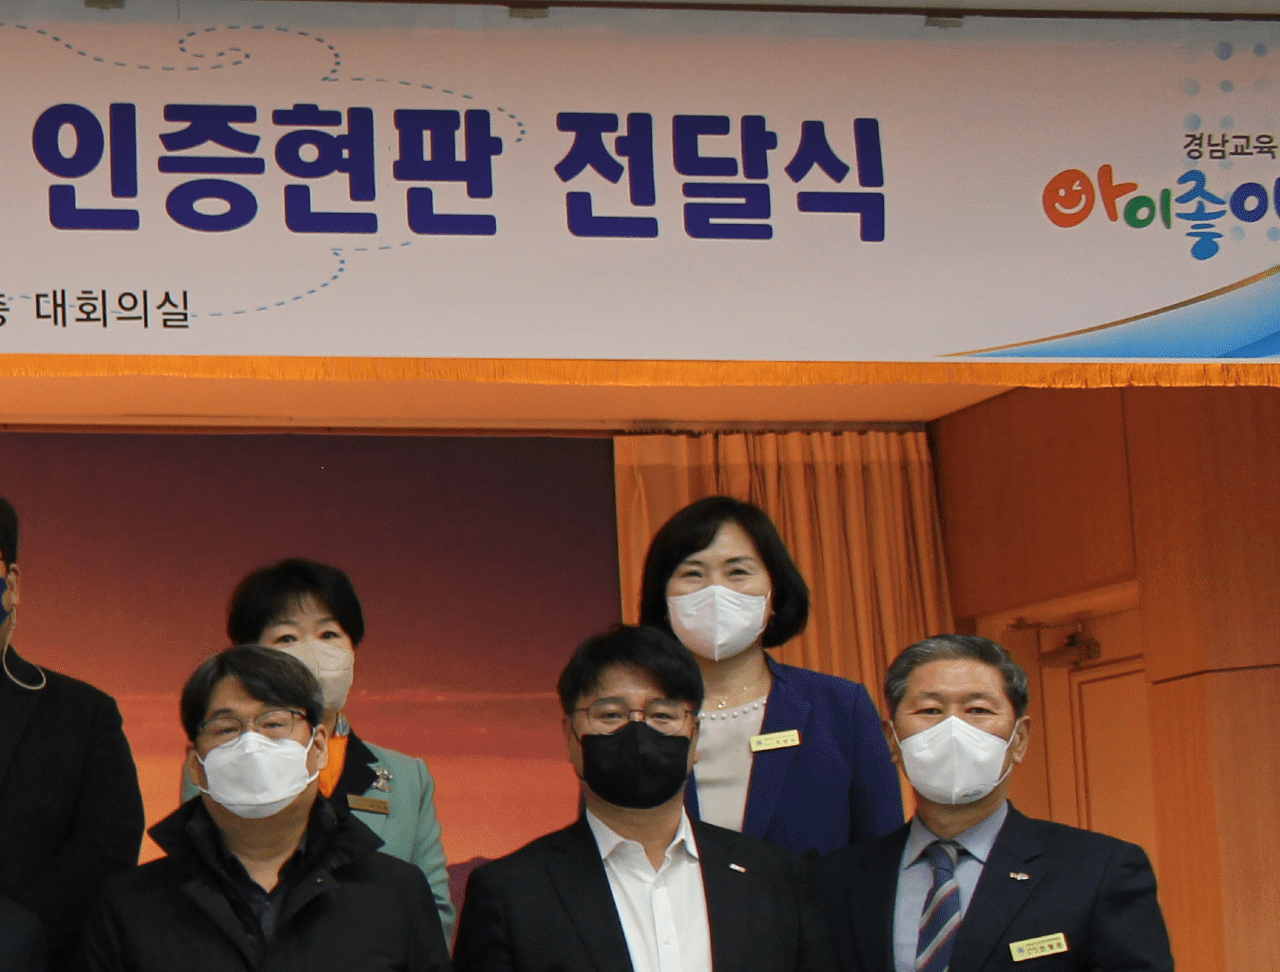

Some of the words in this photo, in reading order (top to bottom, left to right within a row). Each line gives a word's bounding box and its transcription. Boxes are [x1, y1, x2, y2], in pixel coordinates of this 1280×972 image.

[1184, 133, 1278, 160] 경남교육
[32, 104, 502, 235] 인증현판
[554, 113, 884, 241] 전달식
[36, 290, 188, 328] 대회의실
